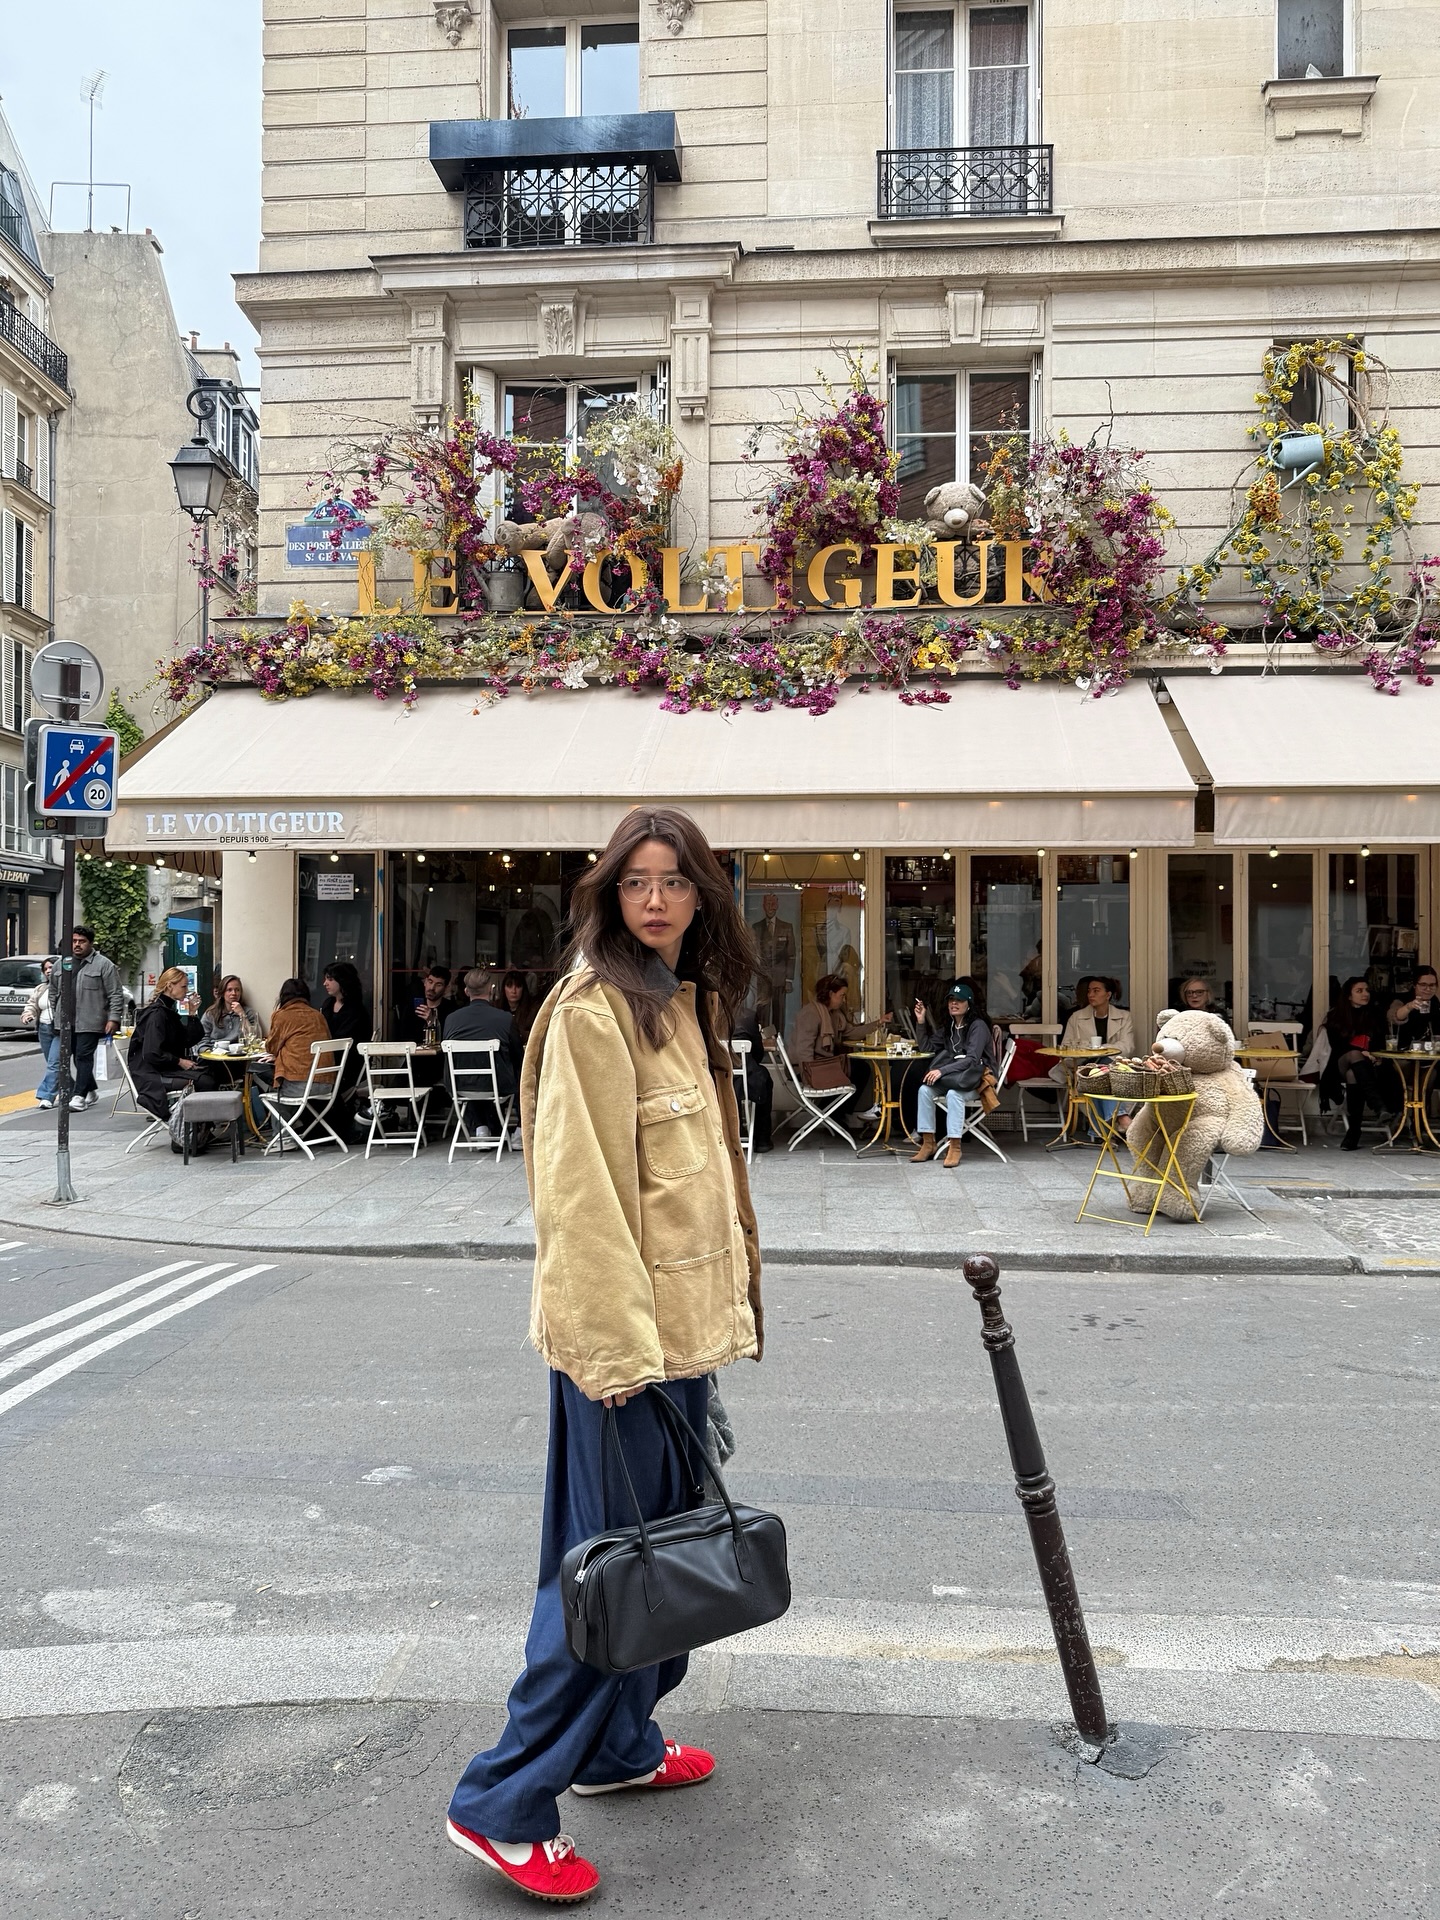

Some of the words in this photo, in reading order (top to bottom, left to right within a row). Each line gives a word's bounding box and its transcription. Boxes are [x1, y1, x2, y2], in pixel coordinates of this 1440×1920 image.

[289, 541, 305, 551] DES
[349, 548, 461, 615] LE
[90, 789, 106, 800] 20
[146, 814, 177, 835] LE
[184, 812, 345, 834] VOLTIGEUR
[219, 836, 249, 844] DEPUIS
[250, 835, 270, 843] 1906
[183, 934, 196, 953] P
